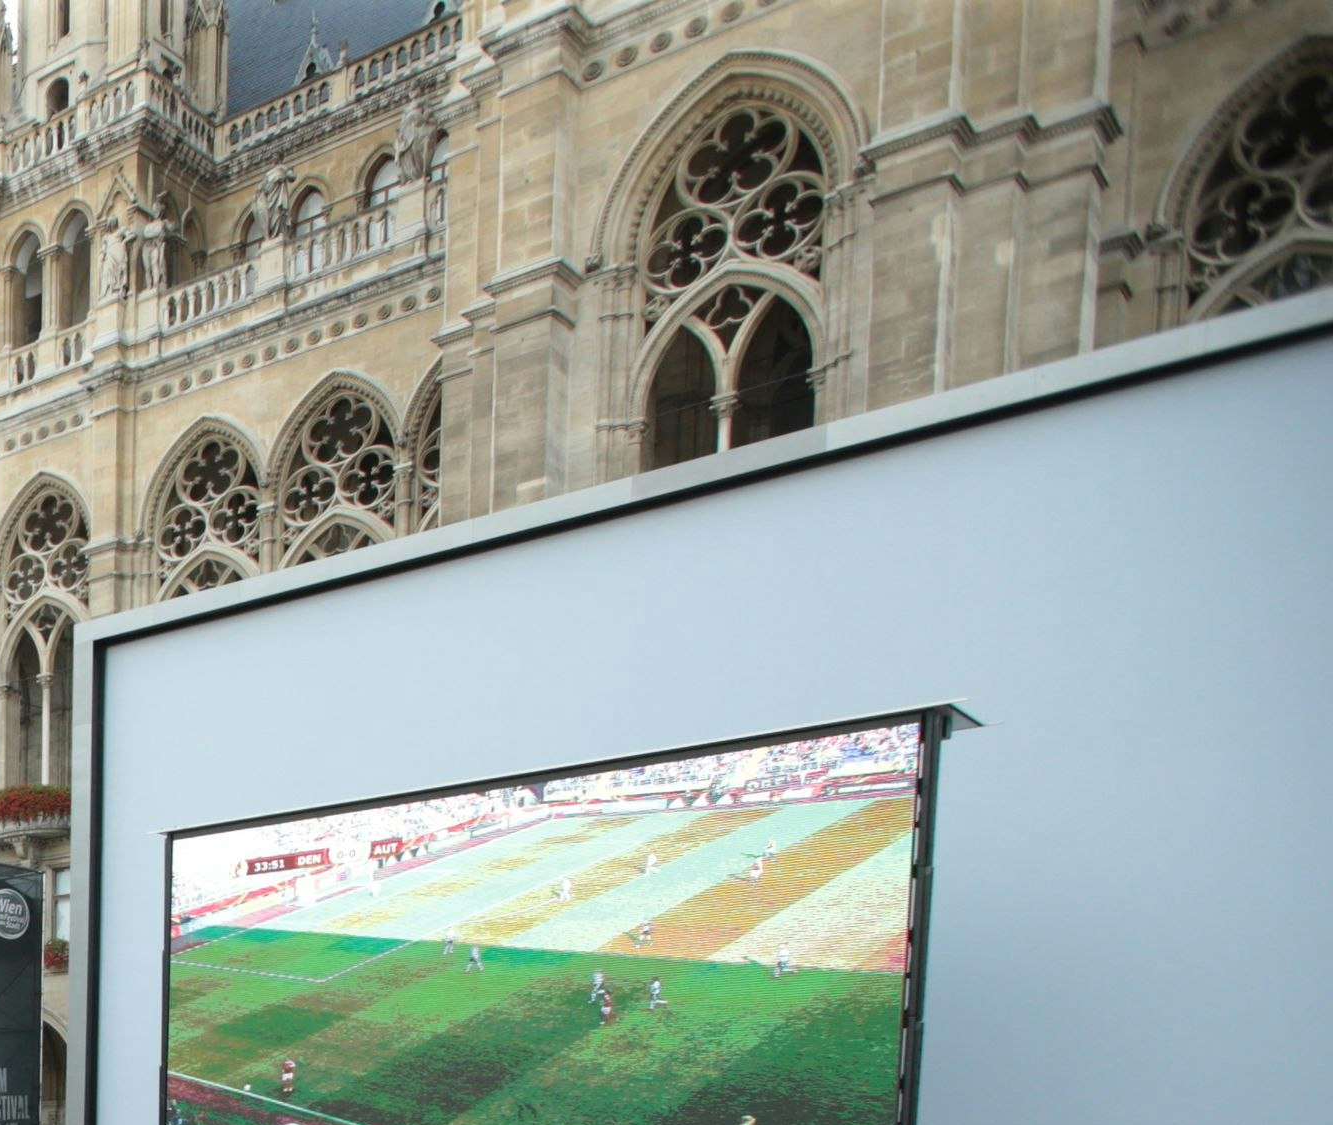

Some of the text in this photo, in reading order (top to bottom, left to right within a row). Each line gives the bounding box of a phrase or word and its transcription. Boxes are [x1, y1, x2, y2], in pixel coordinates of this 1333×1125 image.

[374, 842, 399, 855] AUT
[253, 859, 285, 873] 33:51
[297, 853, 322, 866] DEN
